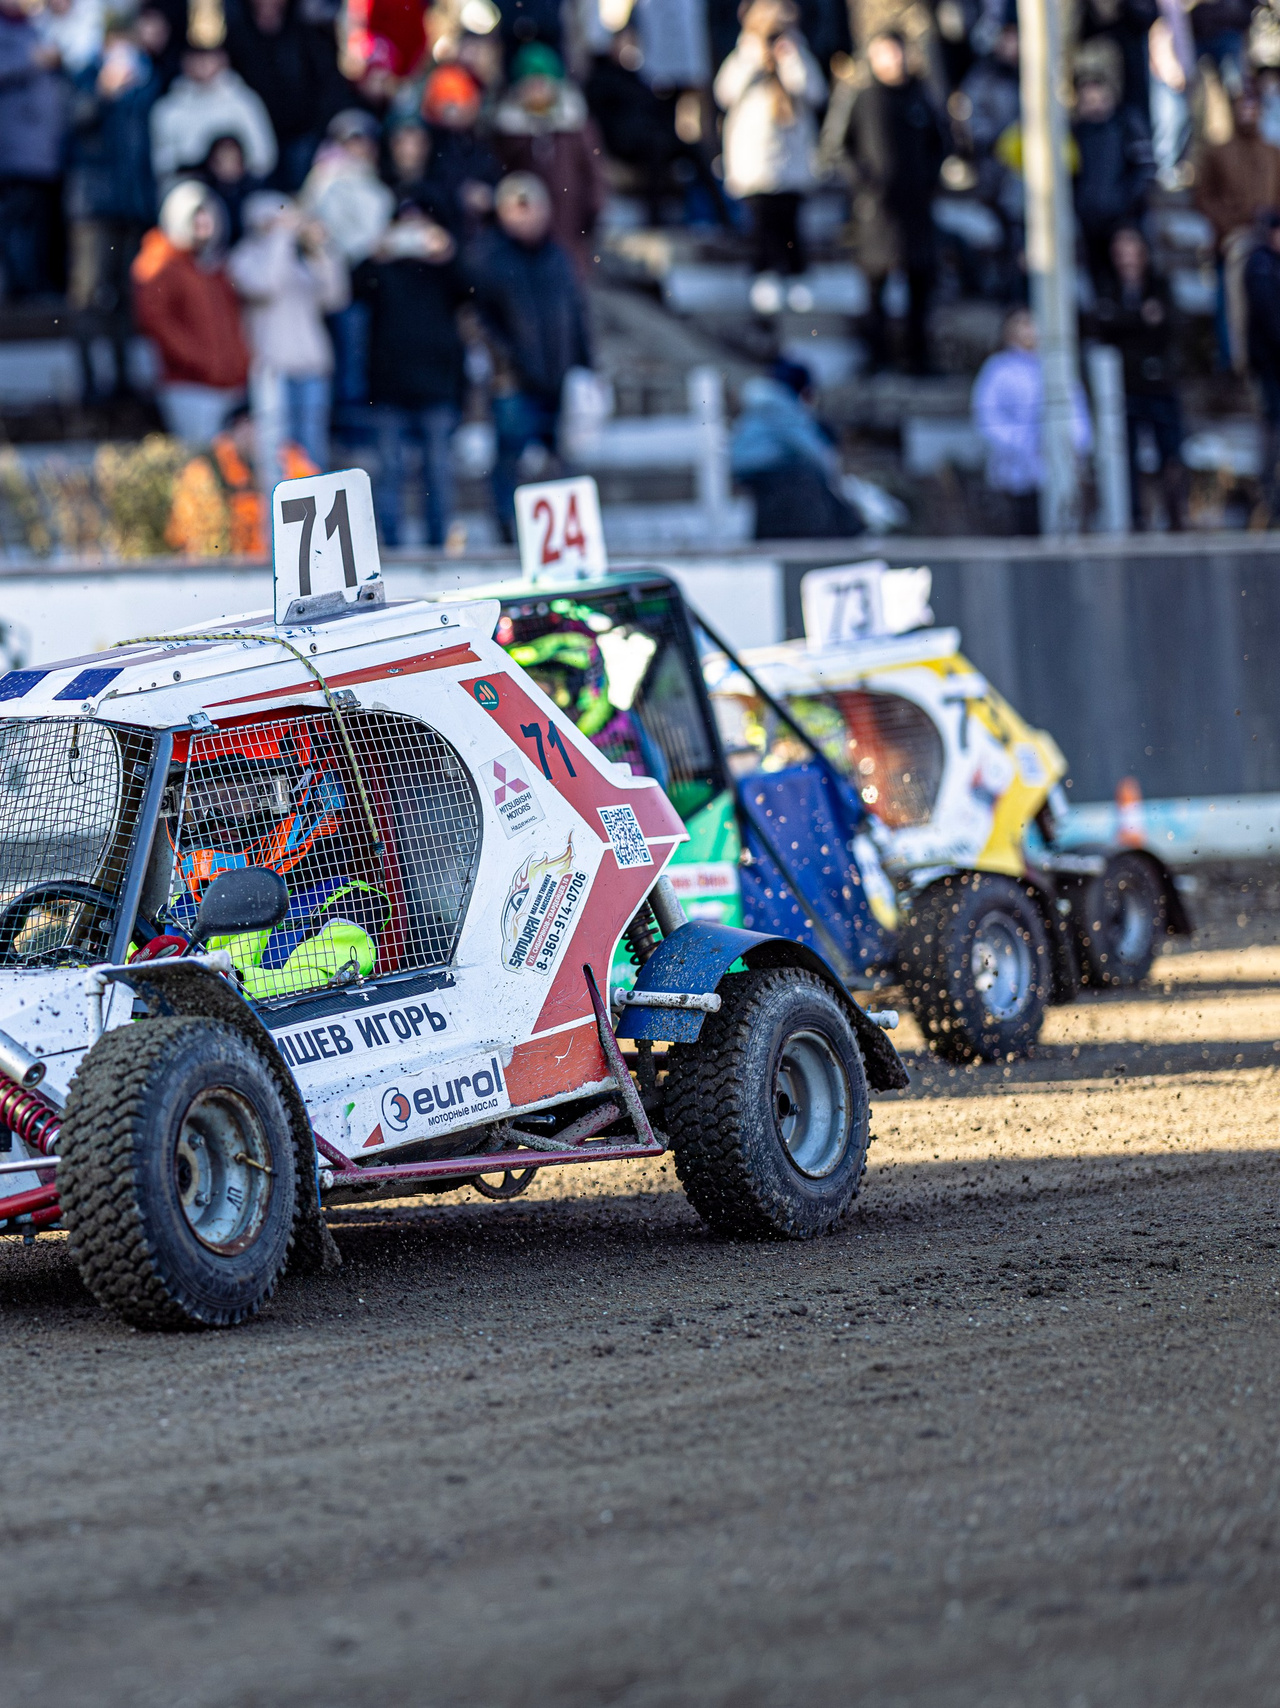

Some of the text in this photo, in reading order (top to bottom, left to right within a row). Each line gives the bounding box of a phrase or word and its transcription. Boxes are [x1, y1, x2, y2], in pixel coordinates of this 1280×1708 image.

[281, 489, 357, 596] 71
[533, 493, 586, 564] 24
[520, 721, 578, 780] 71
[499, 792, 532, 815] MITSUBISHI
[506, 803, 531, 821] MOTORS
[508, 915, 540, 968] SAMURAI
[535, 871, 586, 970] 8-960-914-0706
[355, 1003, 447, 1048] ИГОРЬ
[413, 1057, 503, 1114] eurol
[428, 1099, 498, 1126] моторные масла
